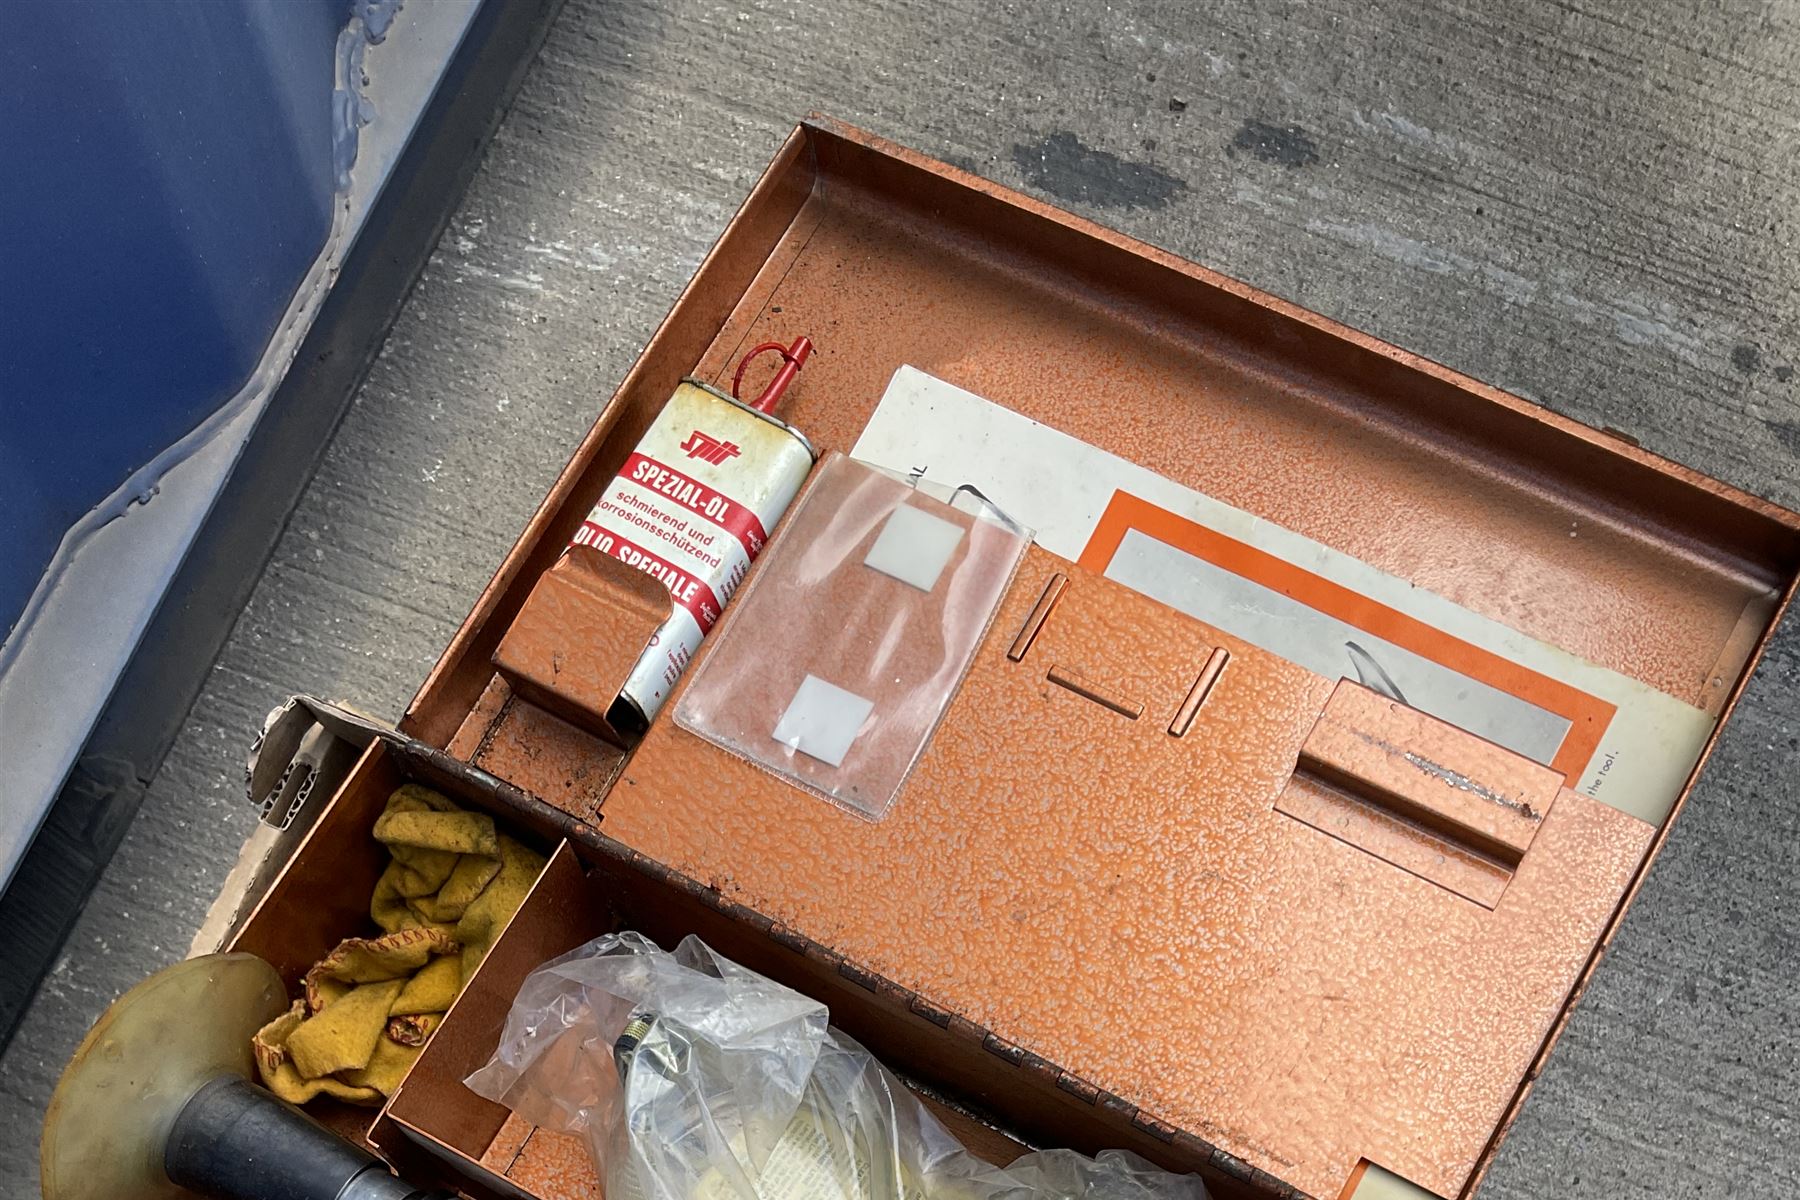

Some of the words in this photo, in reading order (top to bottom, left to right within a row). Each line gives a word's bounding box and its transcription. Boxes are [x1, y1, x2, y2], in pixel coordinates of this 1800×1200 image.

[617, 491, 688, 532] schmierend
[688, 528, 715, 546] und
[632, 461, 729, 523] SPEZIAL-ÖL
[1587, 779, 1602, 796] the
[1597, 751, 1619, 776] tool.
